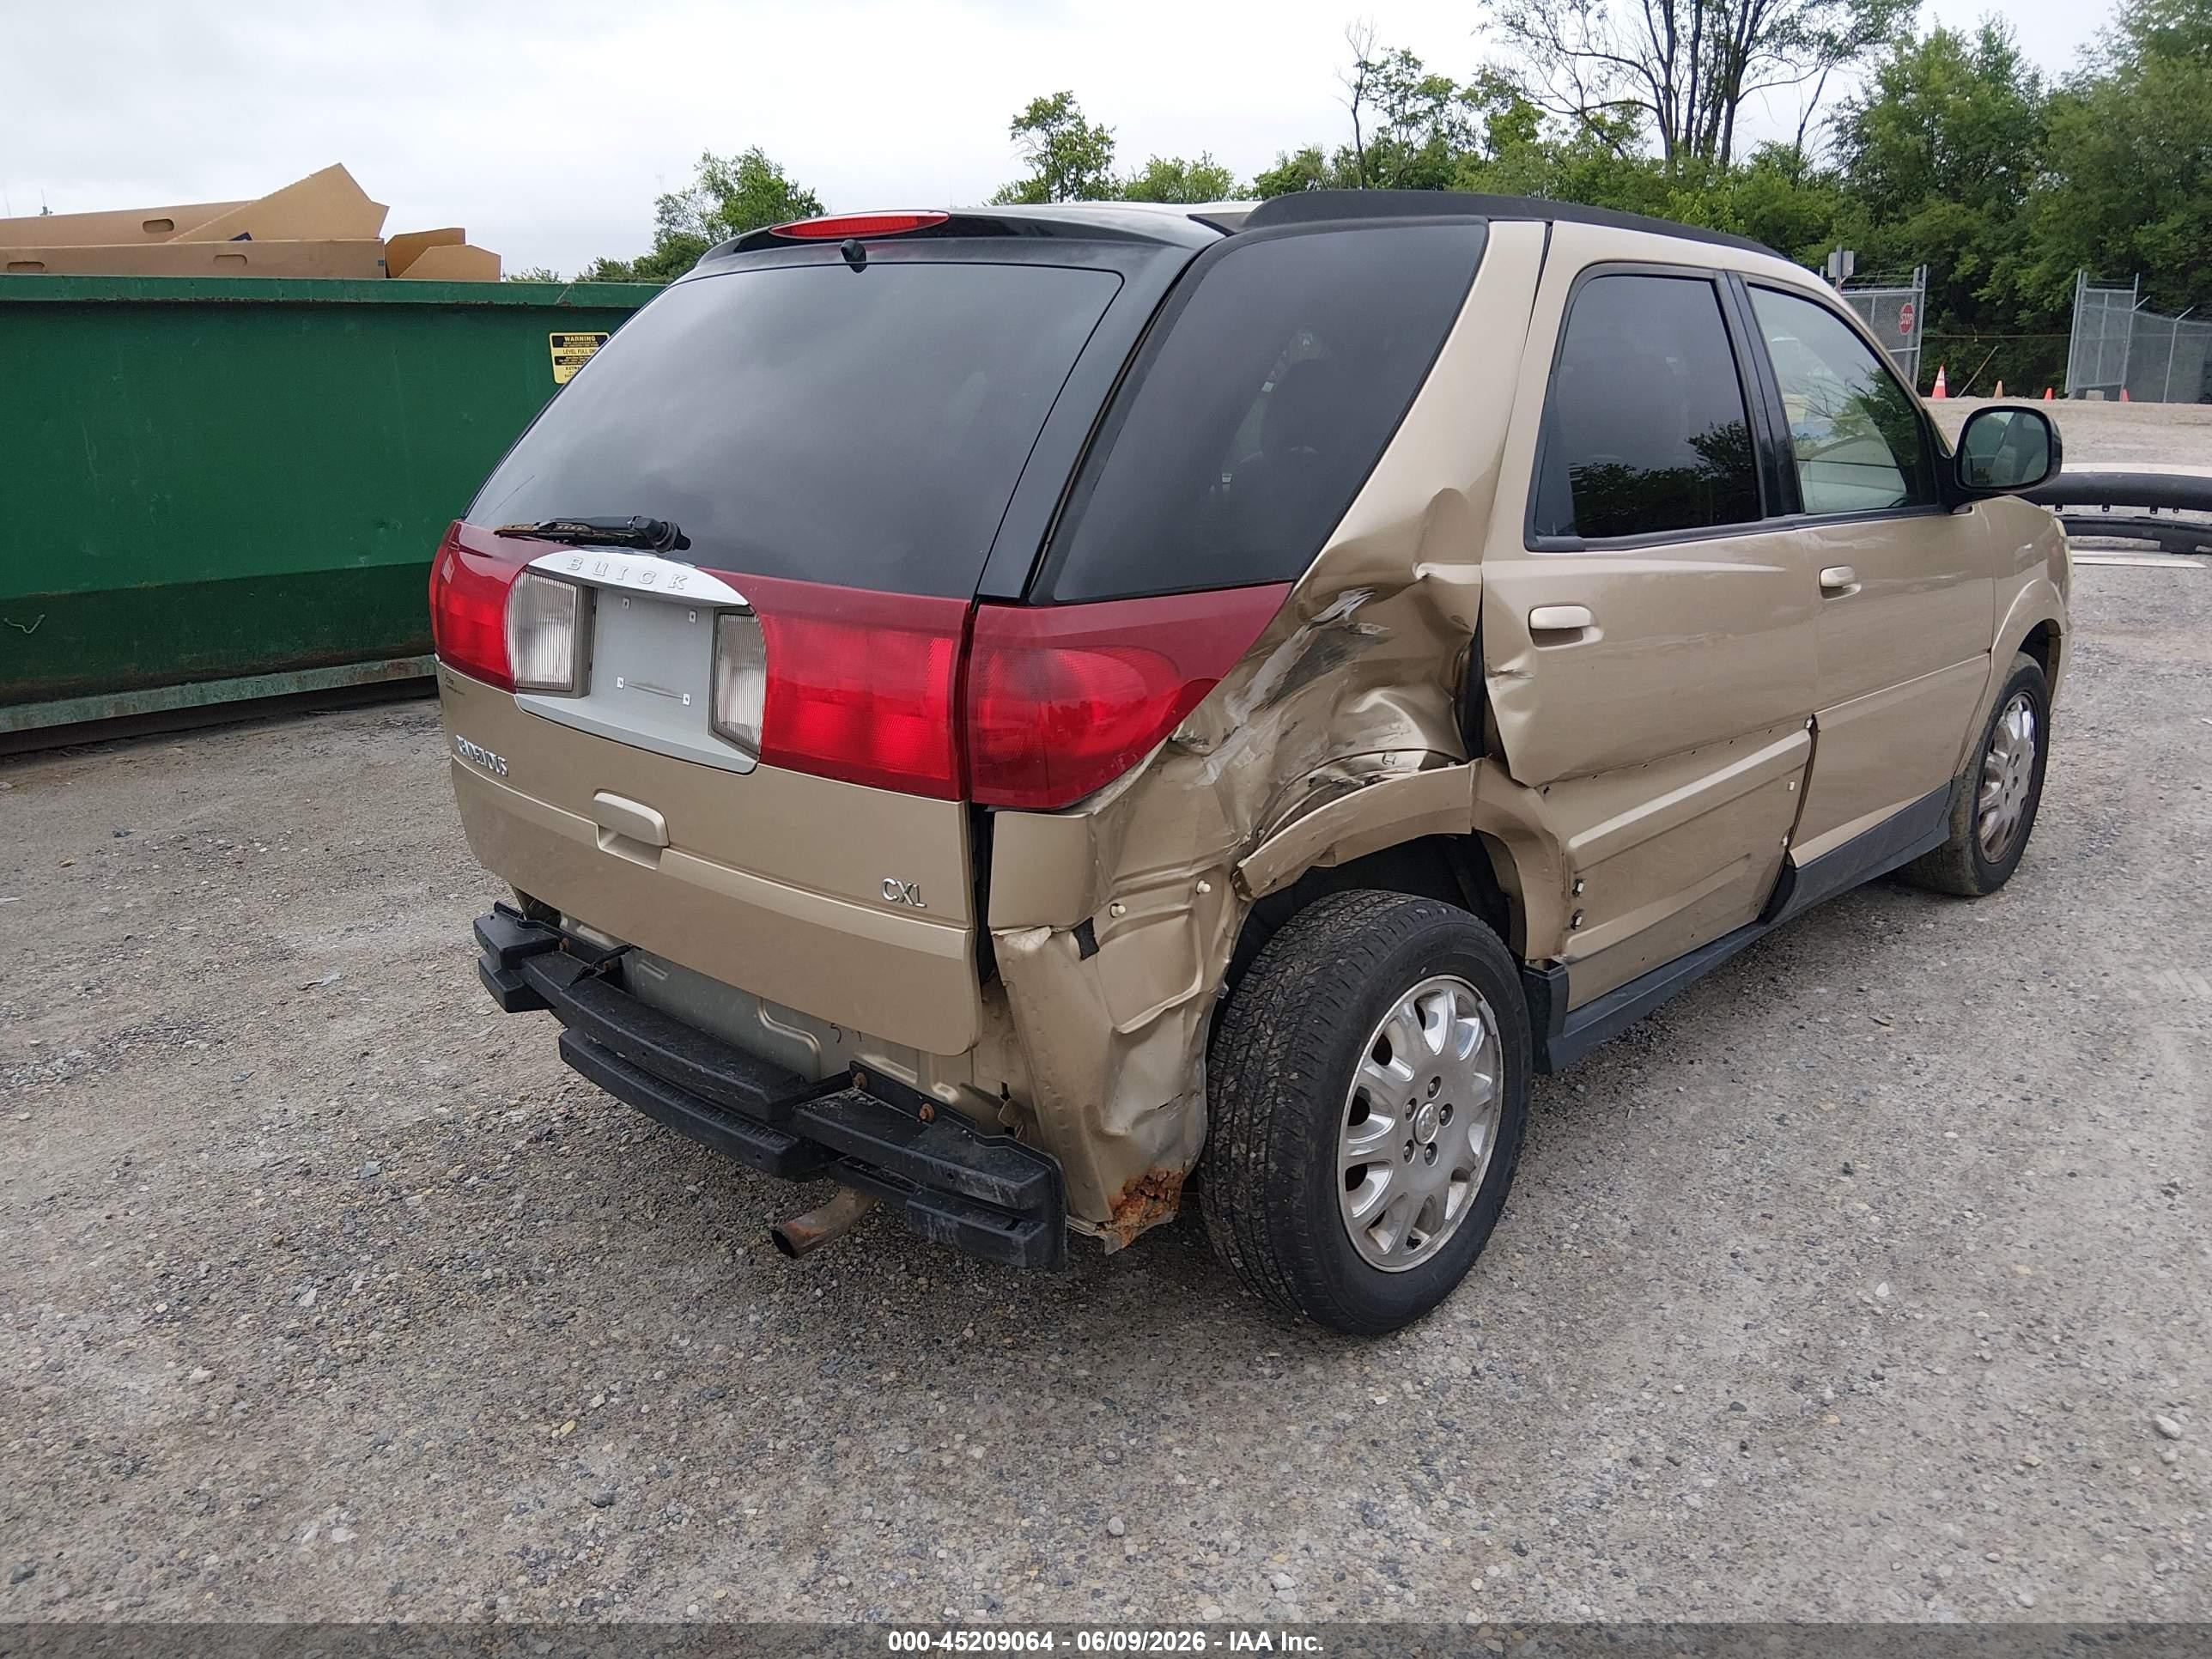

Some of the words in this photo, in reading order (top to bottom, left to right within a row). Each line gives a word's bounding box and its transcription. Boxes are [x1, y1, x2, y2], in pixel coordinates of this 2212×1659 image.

[1900, 313, 1913, 325] STOP
[567, 556, 688, 590] BUICK
[882, 877, 927, 908] CXL
